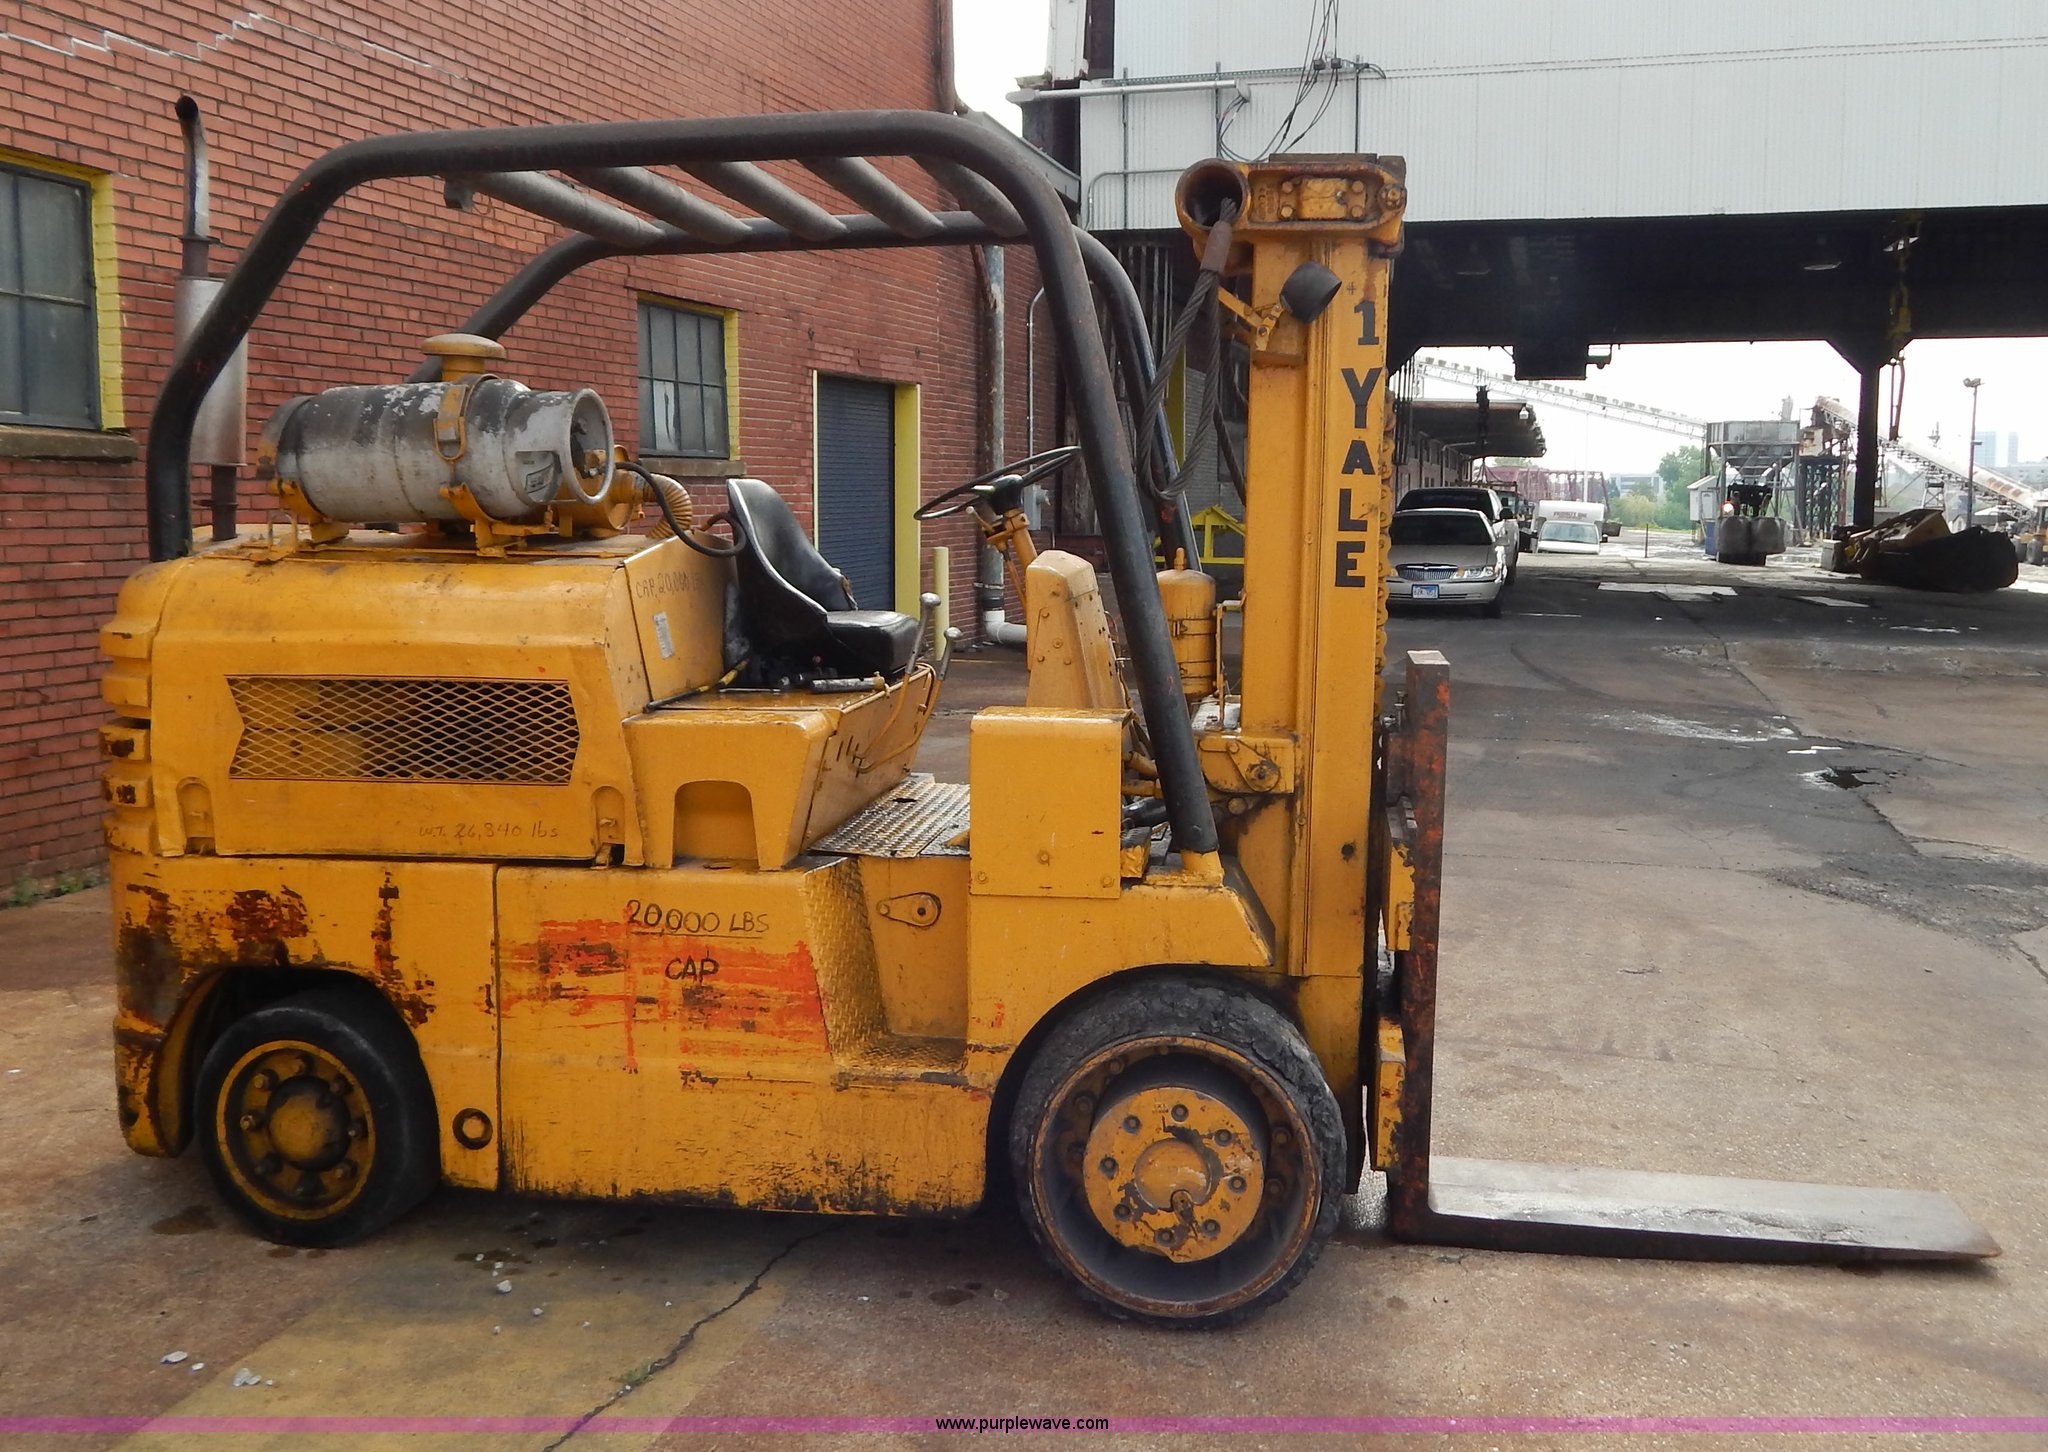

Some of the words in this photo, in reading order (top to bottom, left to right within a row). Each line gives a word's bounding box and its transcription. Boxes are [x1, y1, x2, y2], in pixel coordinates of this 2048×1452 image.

[1354, 301, 1379, 346] 1
[1334, 366, 1383, 588] YALE
[531, 820, 559, 838] lbs
[626, 899, 720, 937] 20,000
[729, 911, 770, 934] LBS
[664, 949, 720, 986] CAP
